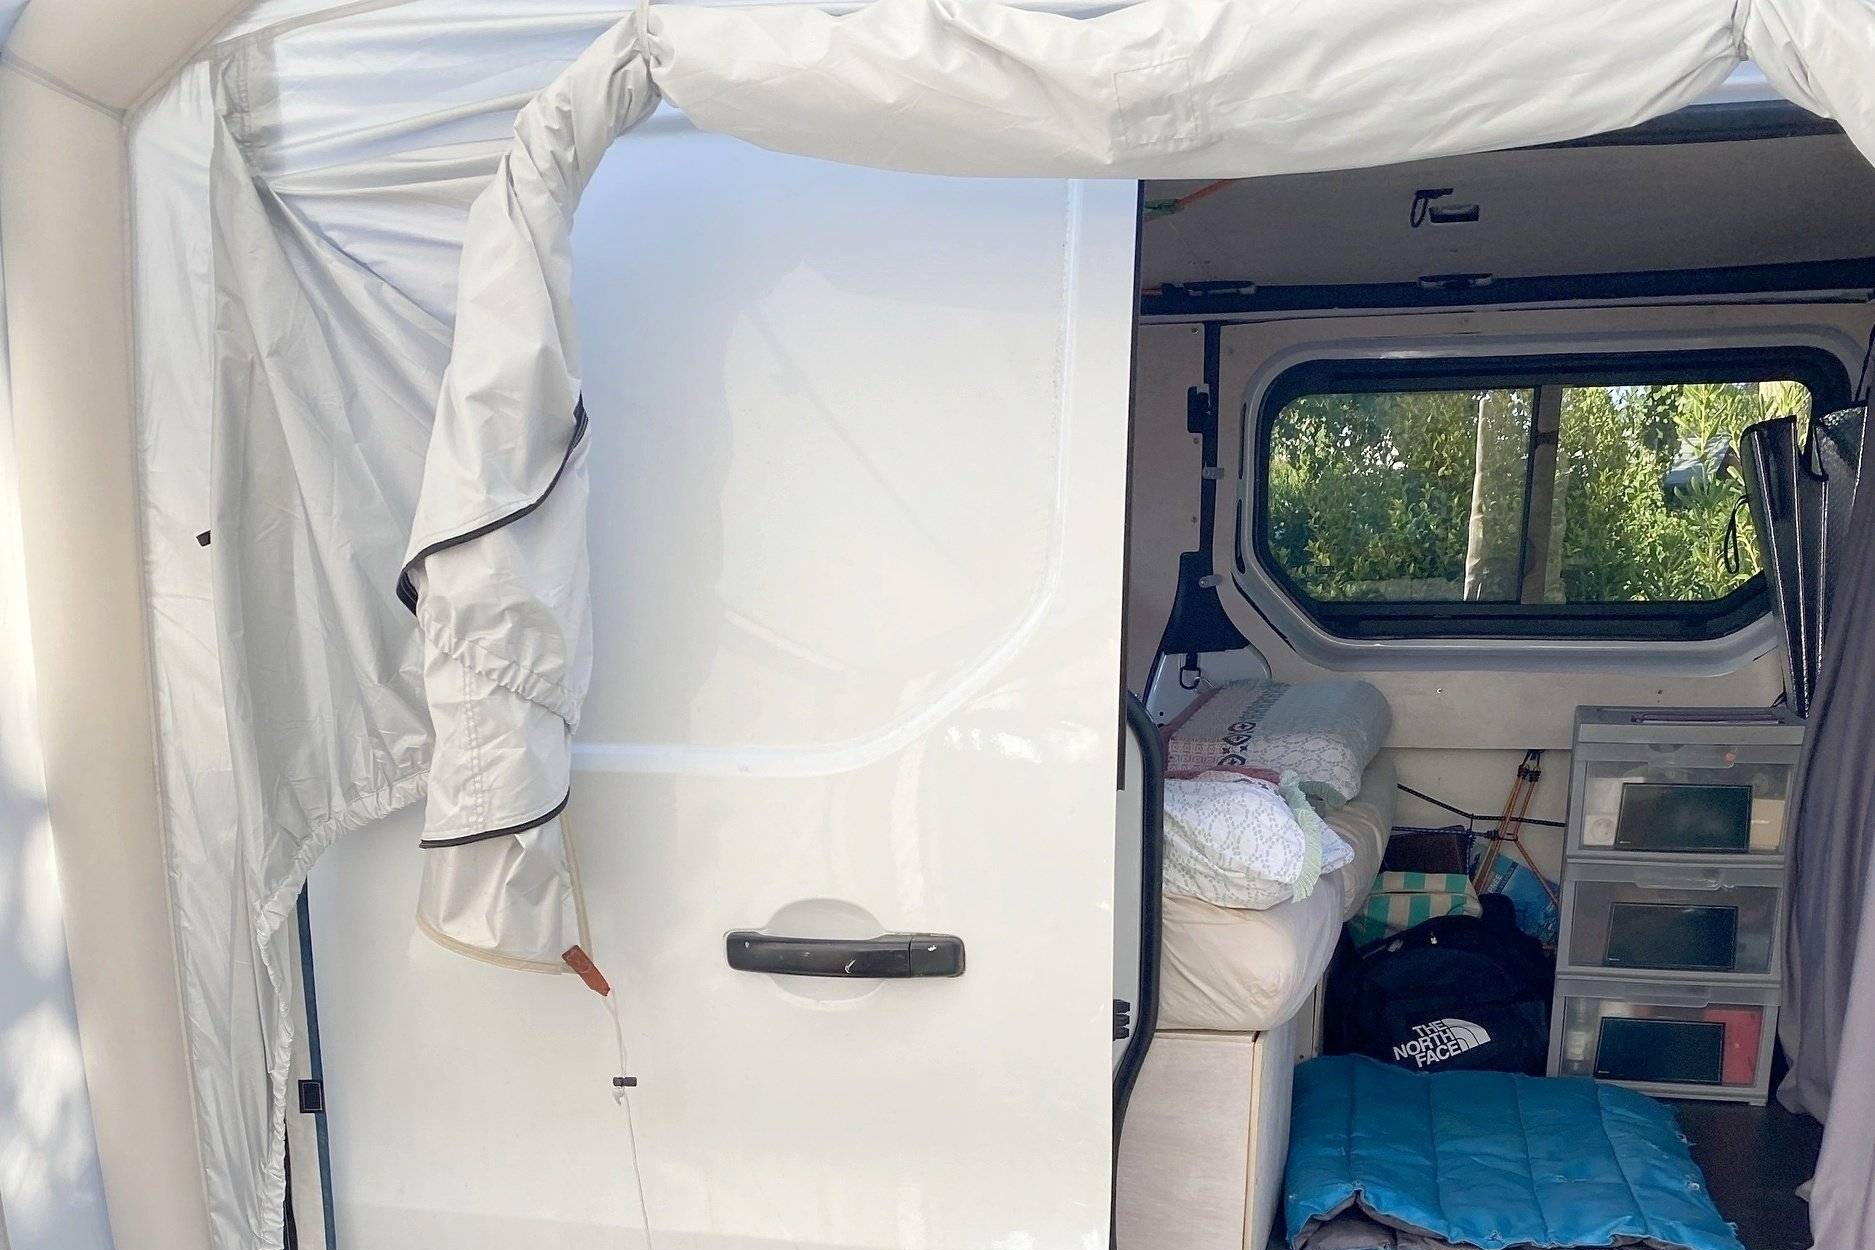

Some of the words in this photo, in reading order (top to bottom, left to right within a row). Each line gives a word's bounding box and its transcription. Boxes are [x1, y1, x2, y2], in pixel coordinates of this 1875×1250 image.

[1412, 1020, 1448, 1037] THE
[1393, 1029, 1455, 1061] NORTH
[1415, 1040, 1461, 1068] FACE
